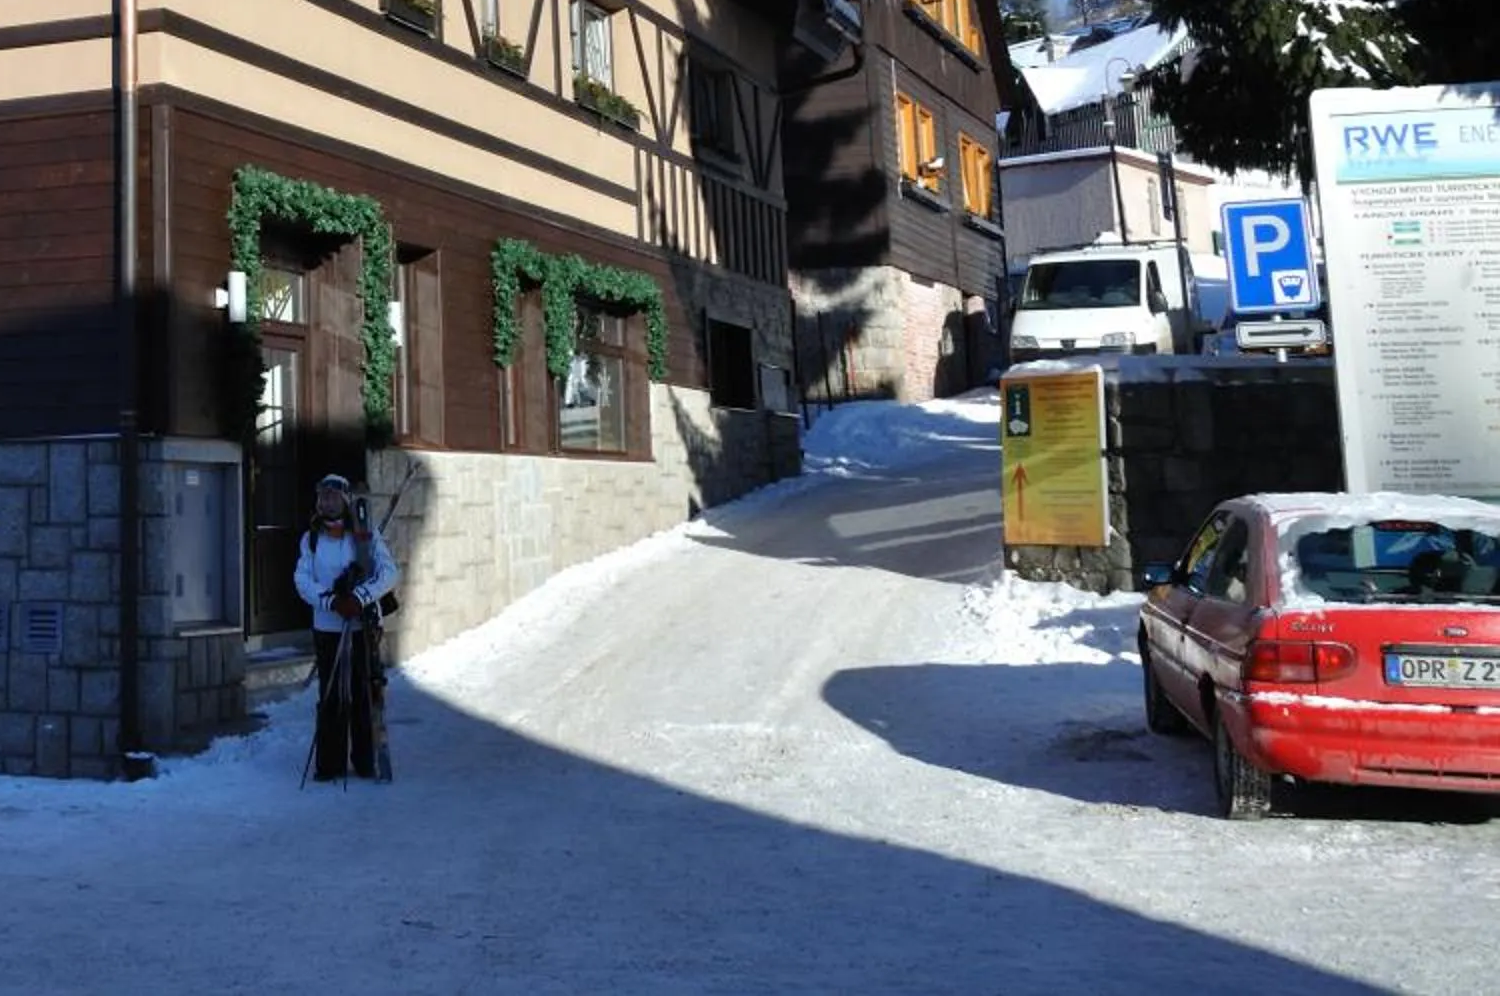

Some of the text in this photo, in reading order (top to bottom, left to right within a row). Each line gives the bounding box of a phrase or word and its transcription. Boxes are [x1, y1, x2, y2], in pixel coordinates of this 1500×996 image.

[1343, 121, 1500, 151] RWE ENE
[1241, 215, 1291, 277] P
[1402, 659, 1500, 681] OPR Z 2
